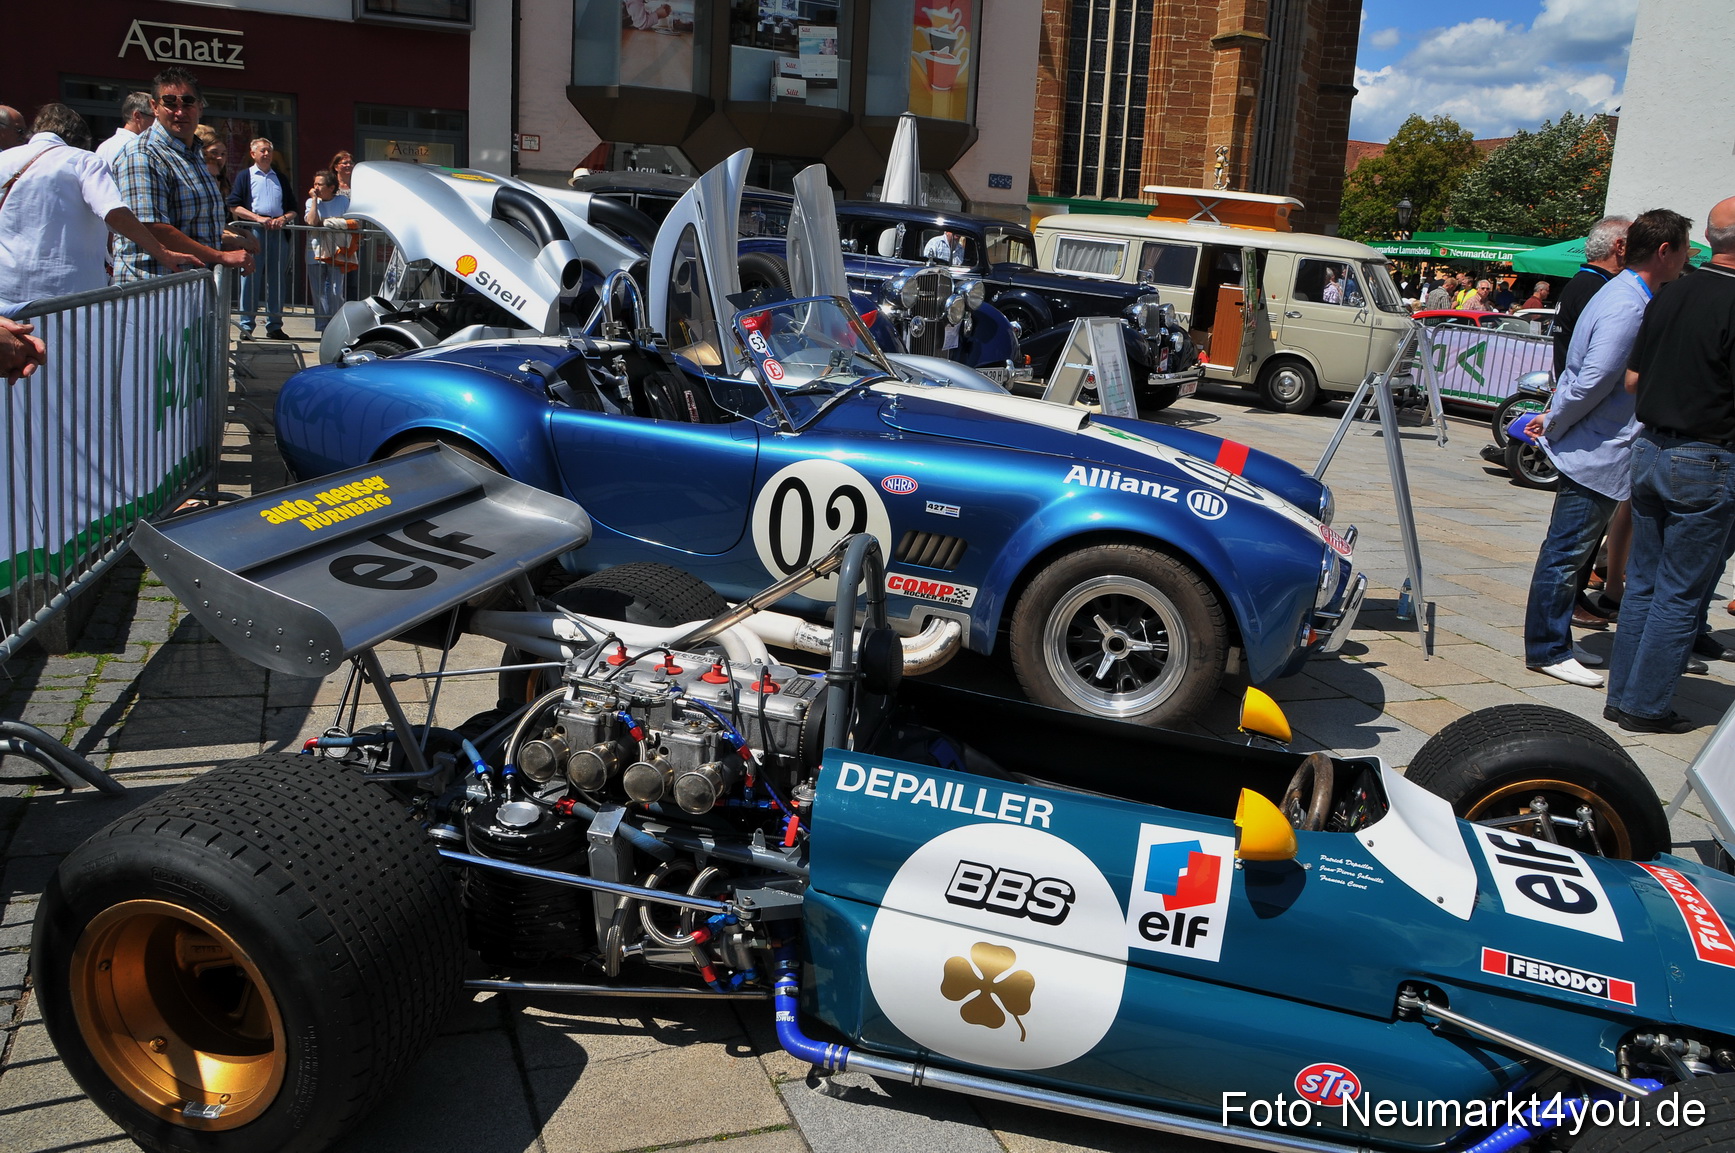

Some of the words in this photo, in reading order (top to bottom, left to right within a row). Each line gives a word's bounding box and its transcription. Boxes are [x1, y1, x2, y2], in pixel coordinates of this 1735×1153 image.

[118, 19, 244, 66] Achatz
[392, 142, 430, 157] Achatz
[1399, 246, 1431, 255] Lammsbräu
[1450, 249, 1496, 260] Neumarkter
[475, 271, 527, 311] Shell
[751, 336, 766, 350] 53
[260, 475, 391, 525] auto-neuser
[887, 479, 913, 492] NHRA
[1063, 465, 1180, 503] Allianz
[299, 493, 392, 532] NÜRNBERG
[927, 503, 945, 512] 427
[329, 519, 496, 591] elf
[887, 576, 955, 598] COMP
[903, 590, 937, 602] ROCKER
[938, 594, 964, 607] ARMS
[836, 762, 1054, 829] DEPAILLER
[1320, 854, 1344, 864] Patrick
[1486, 832, 1598, 914] elf
[945, 860, 1076, 926] BBS
[1138, 911, 1210, 949] elf
[1512, 958, 1602, 995] FERODO
[1301, 1069, 1355, 1098] STP
